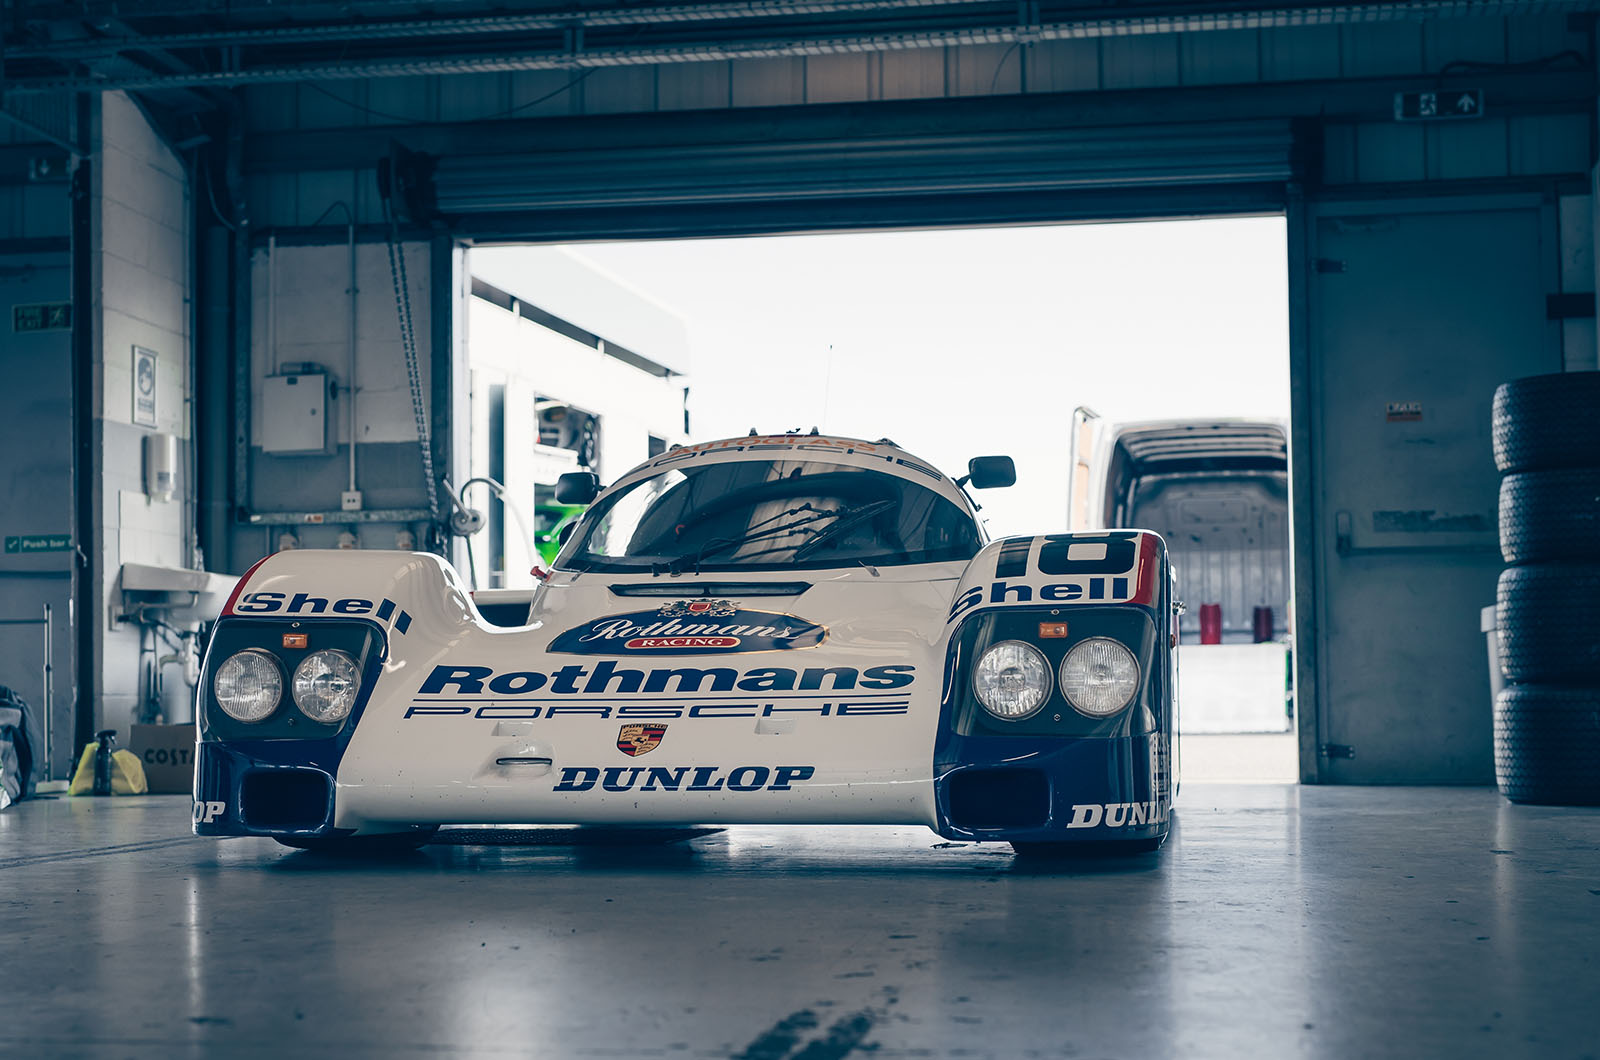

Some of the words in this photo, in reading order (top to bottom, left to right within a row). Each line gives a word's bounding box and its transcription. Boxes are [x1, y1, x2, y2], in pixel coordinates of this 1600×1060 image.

[669, 438, 876, 457] AUTOGLASS
[23, 539, 47, 548] Push
[49, 539, 65, 548] bar
[237, 592, 413, 635] Shell
[947, 578, 1128, 624] Shell
[578, 618, 801, 642] Rothmans
[641, 638, 723, 647] RACING
[417, 660, 916, 695] Rothmans
[403, 701, 909, 720] PORSCHE
[552, 766, 816, 792] DUNLOP
[1066, 801, 1170, 829] DUNLO
